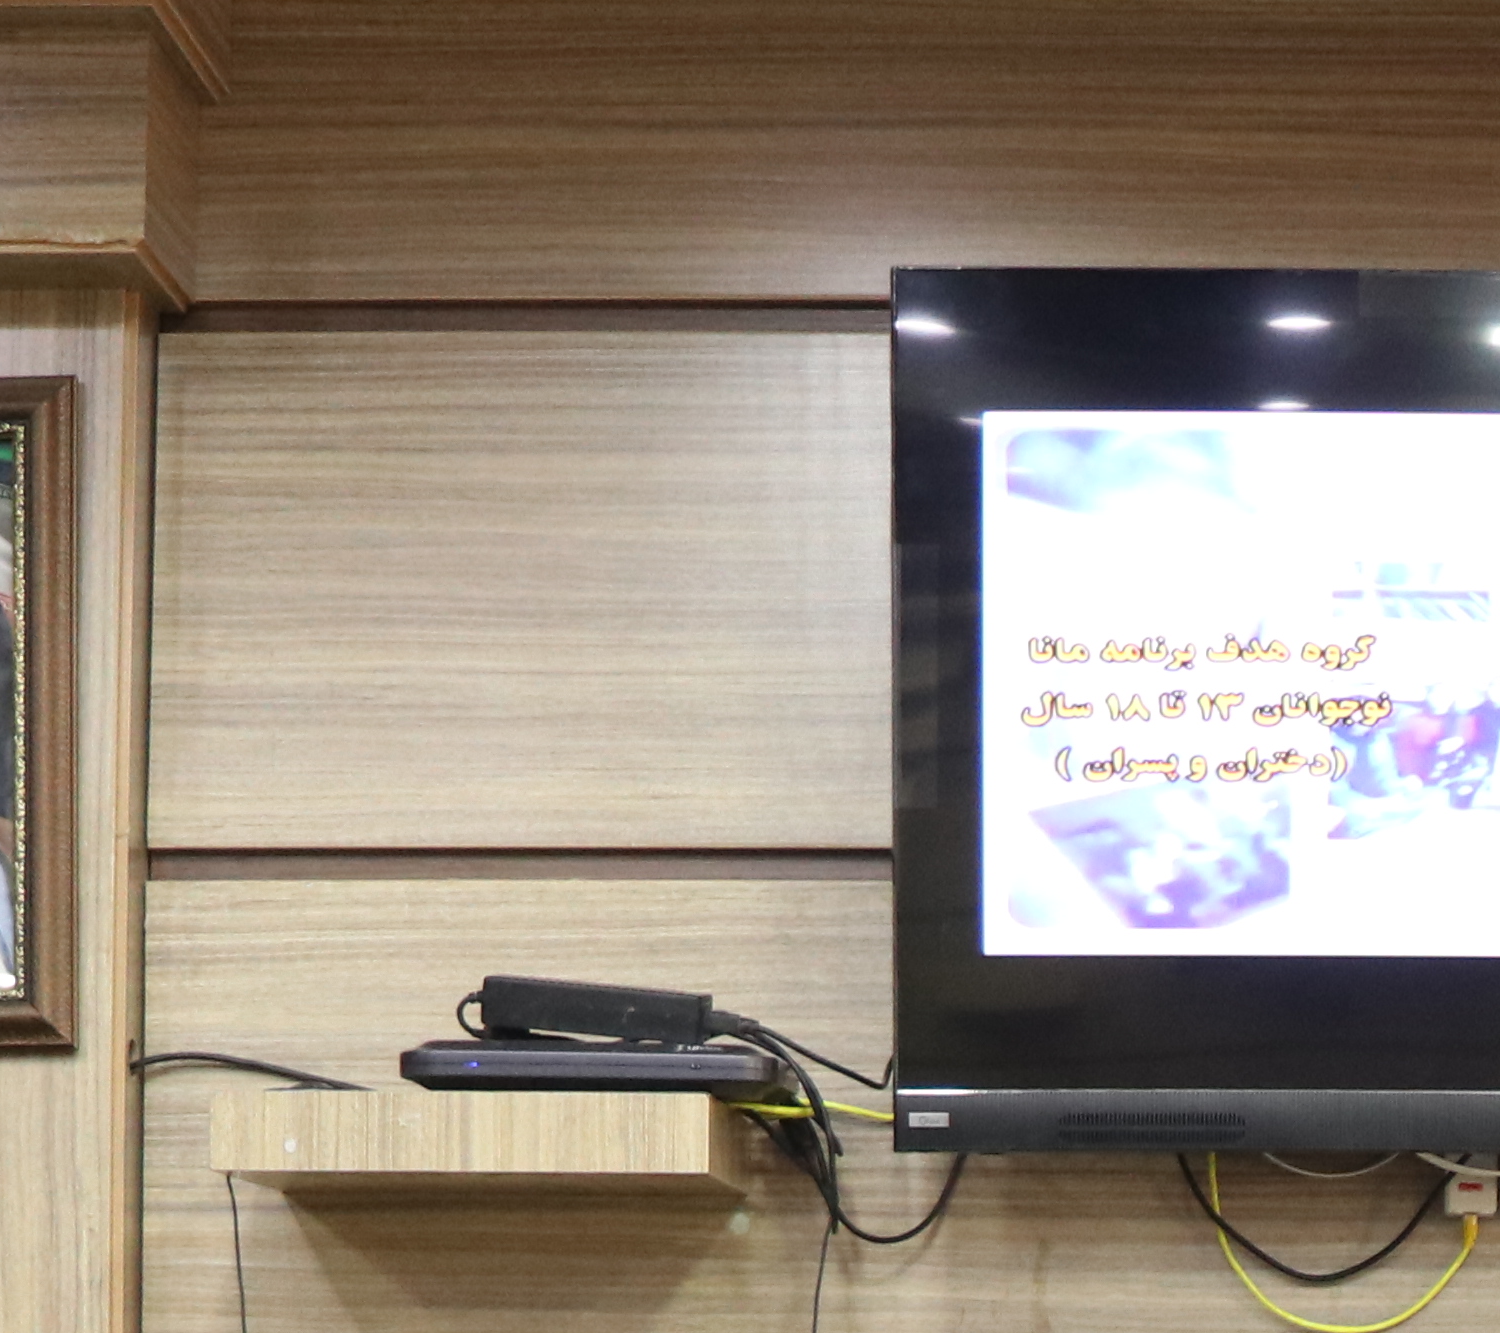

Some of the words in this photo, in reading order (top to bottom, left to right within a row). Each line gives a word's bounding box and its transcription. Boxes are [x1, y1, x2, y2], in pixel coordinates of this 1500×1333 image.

[1028, 635, 1090, 663] مانا
[1100, 635, 1196, 671] برنامه
[1206, 633, 1290, 663] هدف
[1021, 691, 1093, 727] سال
[1158, 690, 1186, 719] تا
[1252, 692, 1392, 727] نوجوانان
[1186, 754, 1208, 783] و
